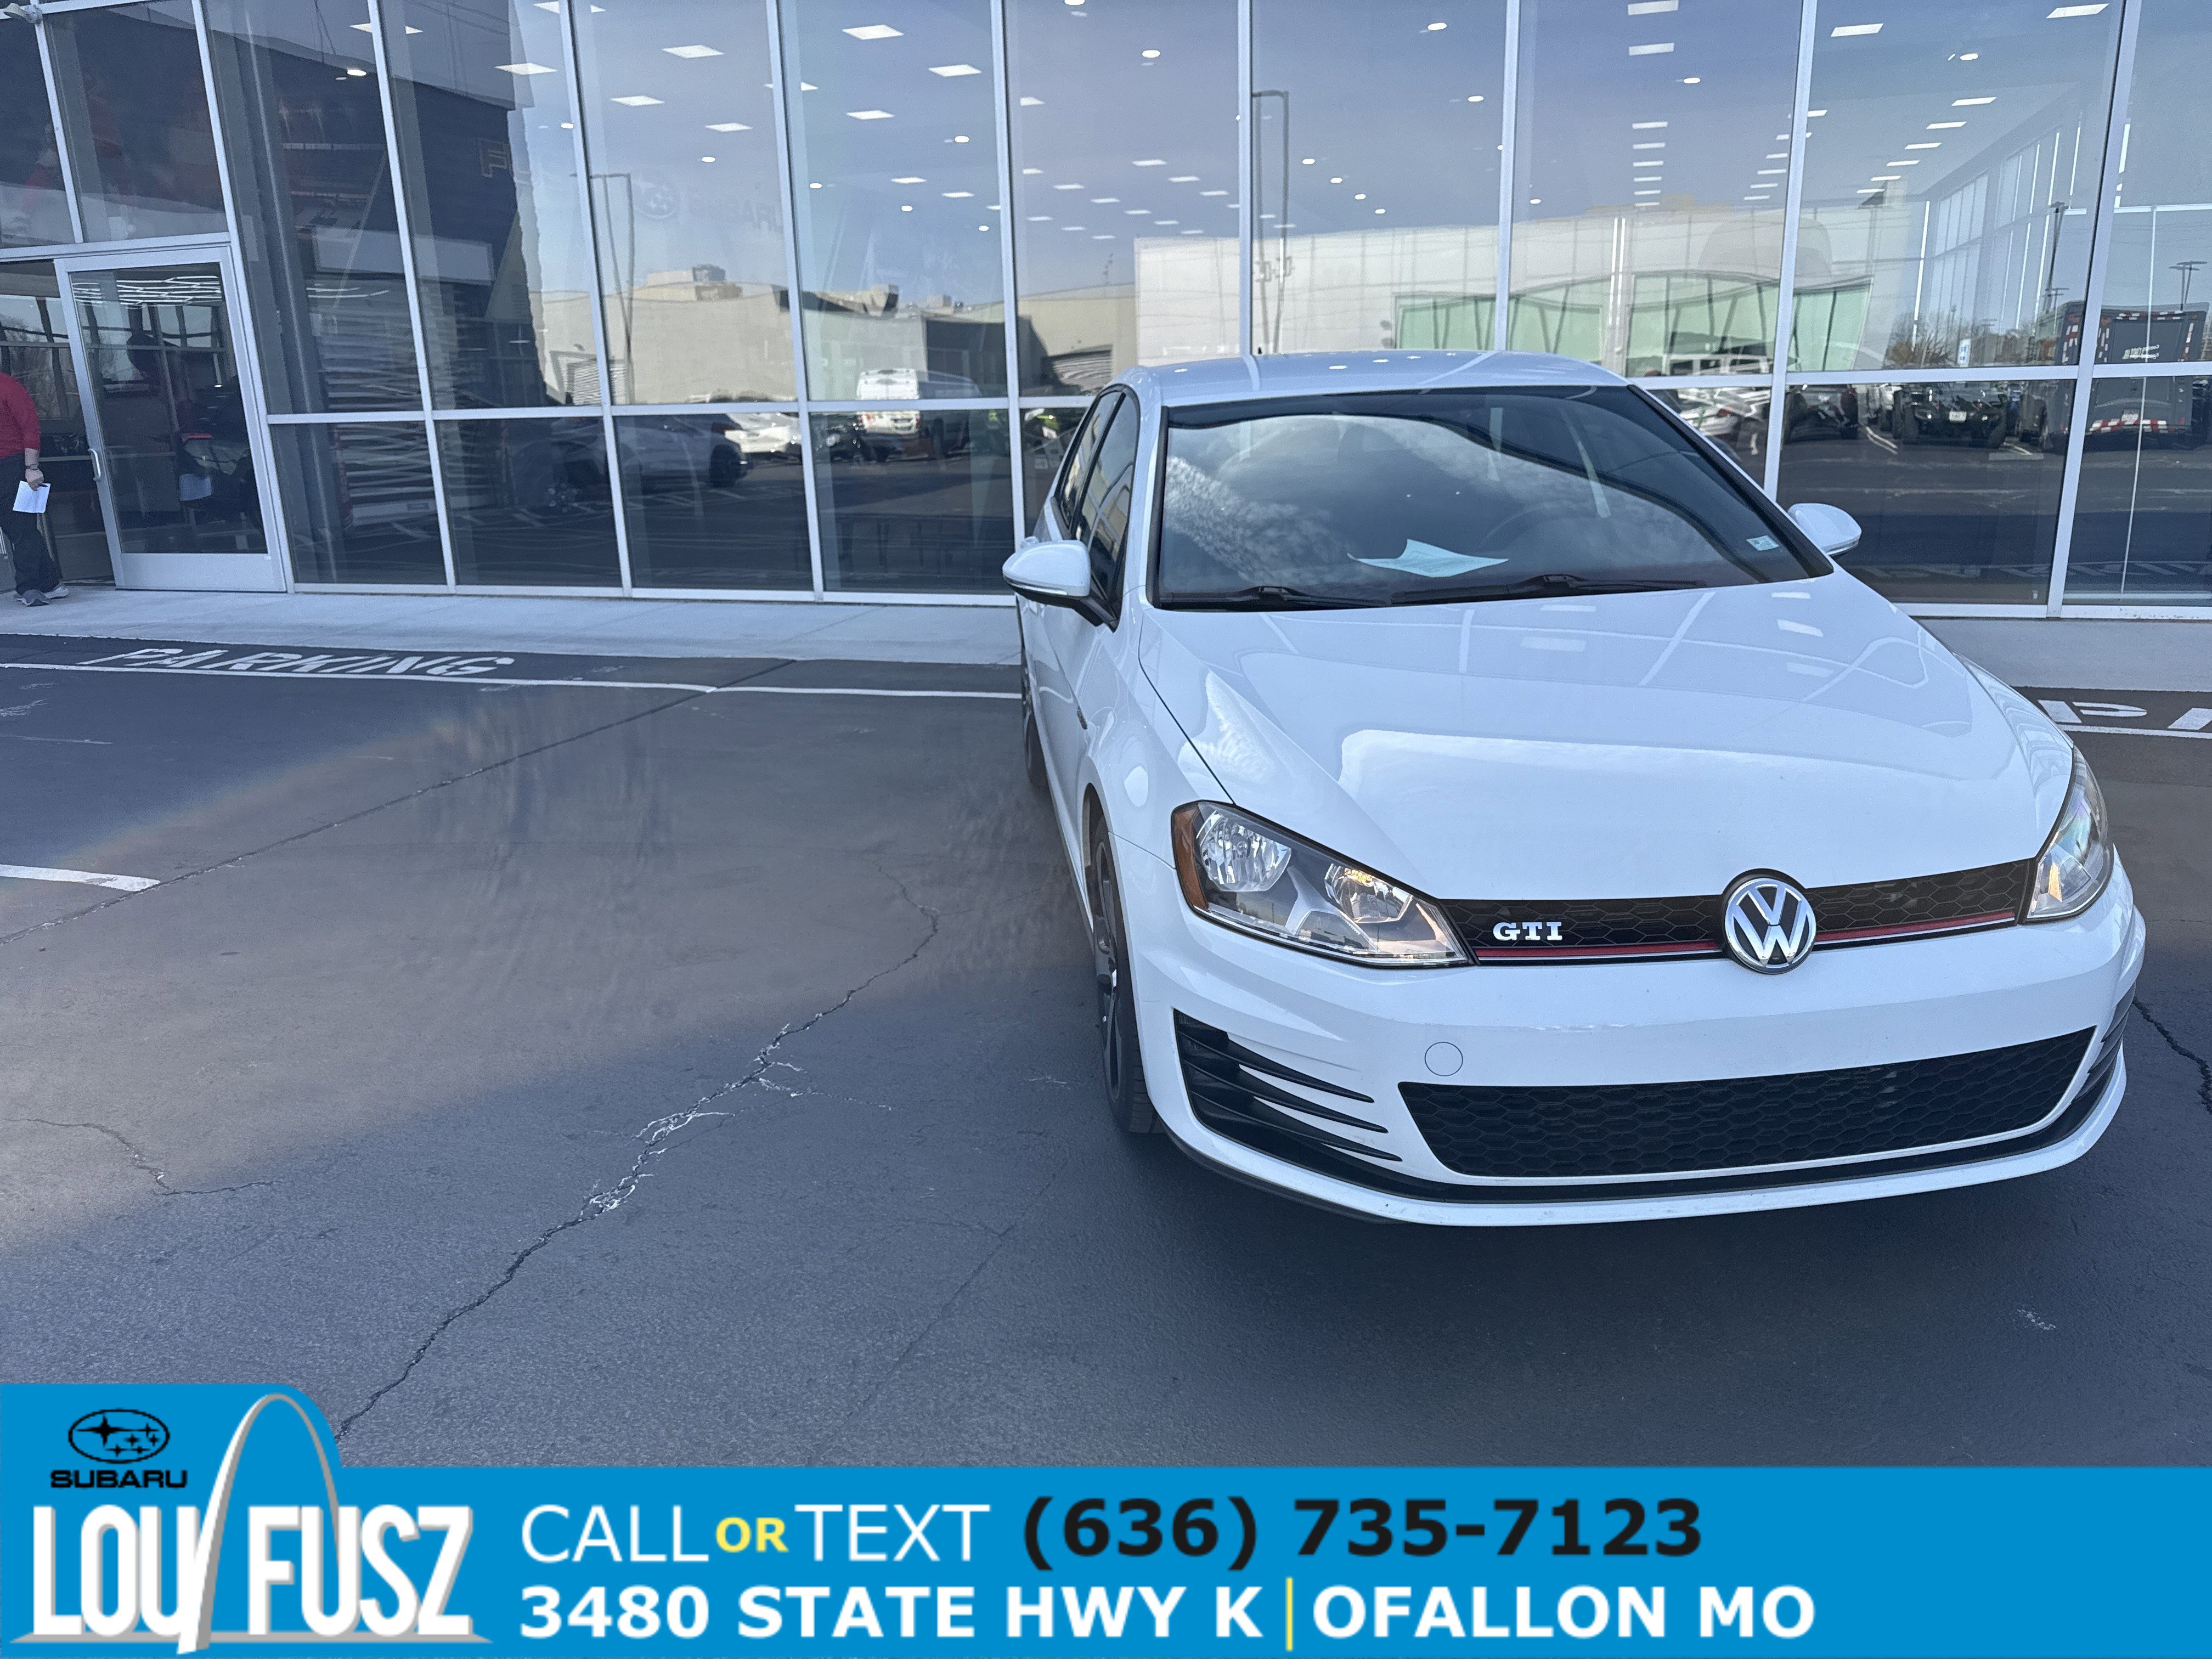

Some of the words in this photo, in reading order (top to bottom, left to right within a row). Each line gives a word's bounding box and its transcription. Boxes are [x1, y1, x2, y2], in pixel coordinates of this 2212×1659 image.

[76, 648, 515, 676] PARKING
[1493, 921, 1562, 941] GTI
[1726, 879, 1816, 971] VW
